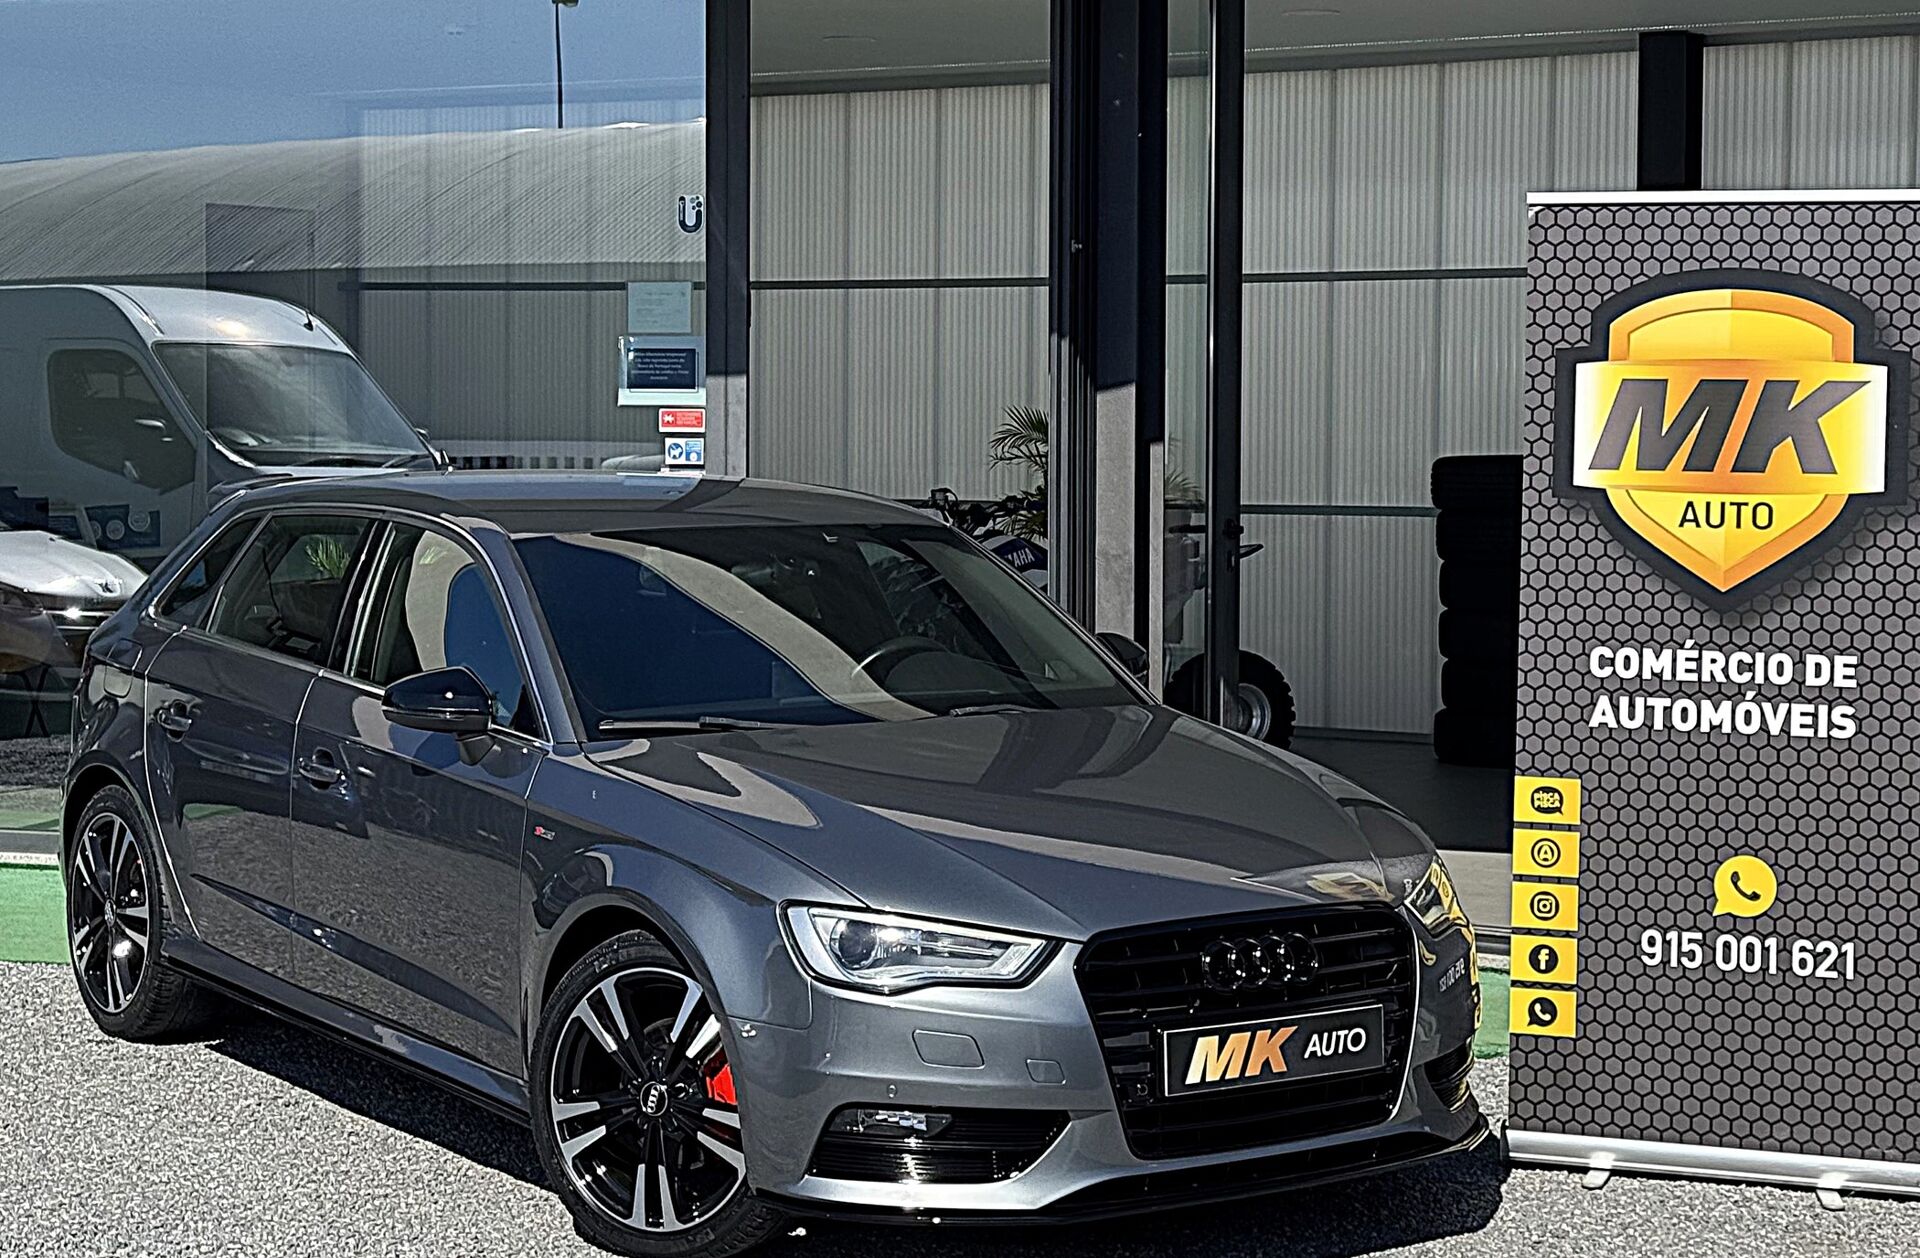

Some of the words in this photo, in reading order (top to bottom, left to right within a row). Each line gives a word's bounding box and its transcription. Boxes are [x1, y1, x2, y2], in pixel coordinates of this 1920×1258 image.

[1588, 378, 1872, 475] MK
[1678, 501, 1774, 530] AUTO
[1588, 639, 1794, 685] COMÉRCIO
[1804, 653, 1859, 689] DE
[1588, 691, 1857, 740] AUTOMÓVEIS
[1639, 928, 1704, 970] 915
[1714, 933, 1779, 975] 001
[1791, 939, 1855, 981] 621
[1184, 1025, 1299, 1085] MK
[1303, 1027, 1367, 1059] AUTO
